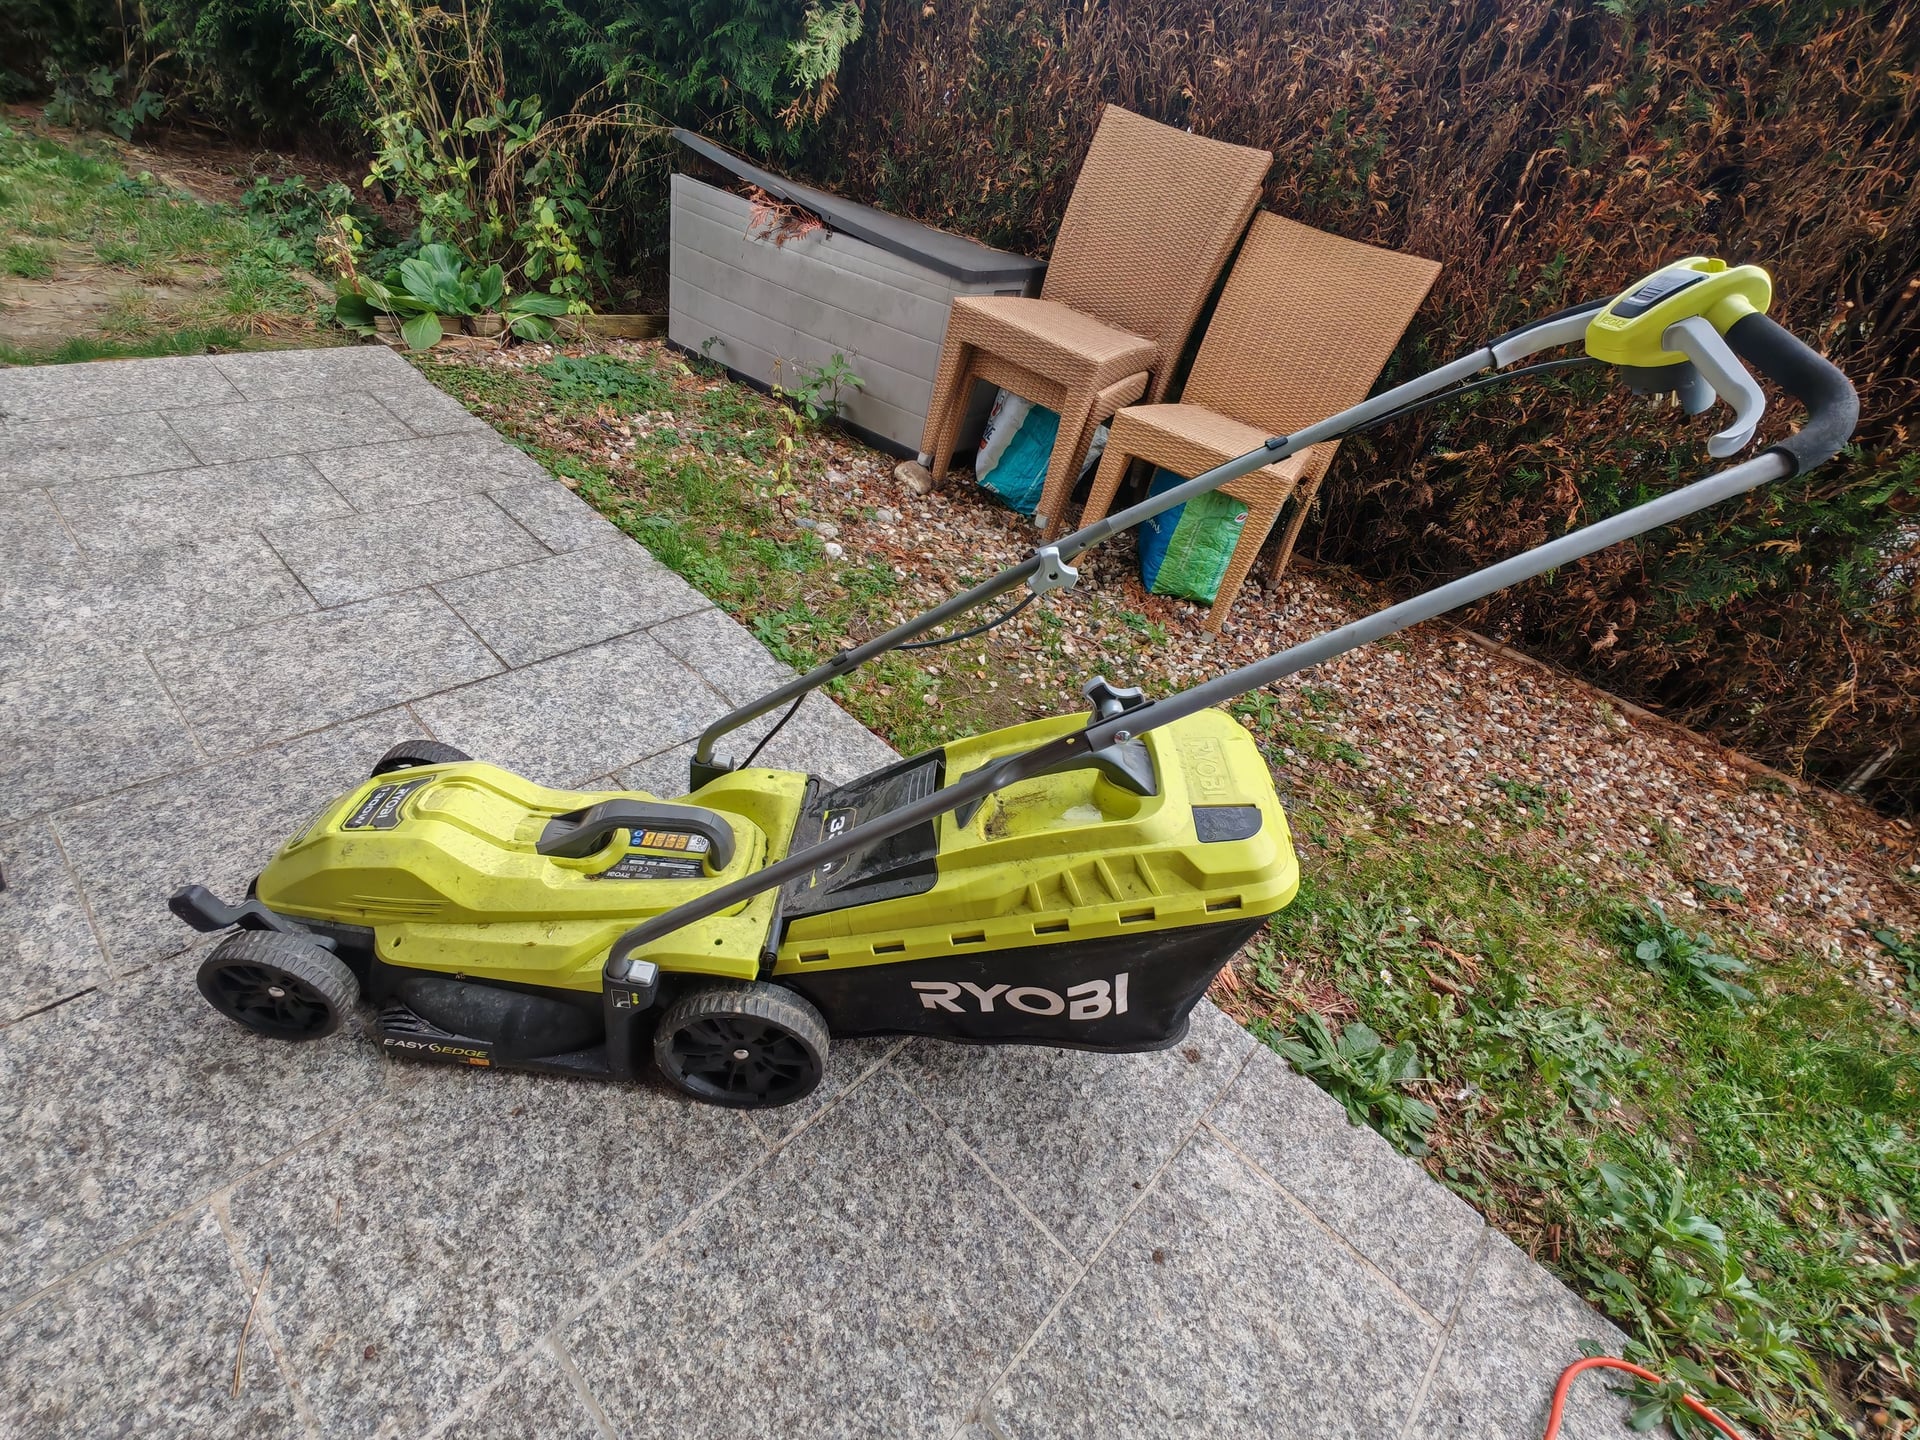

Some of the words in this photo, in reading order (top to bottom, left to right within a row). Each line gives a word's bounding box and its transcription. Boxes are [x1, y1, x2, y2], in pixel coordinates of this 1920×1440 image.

[1183, 740, 1228, 796] RYOBI
[354, 786, 391, 824] 1300W
[376, 787, 411, 819] RYOBI
[910, 972, 1129, 1021] RYOBI
[383, 1038, 428, 1050] EASY
[441, 1046, 489, 1058] EDGE
